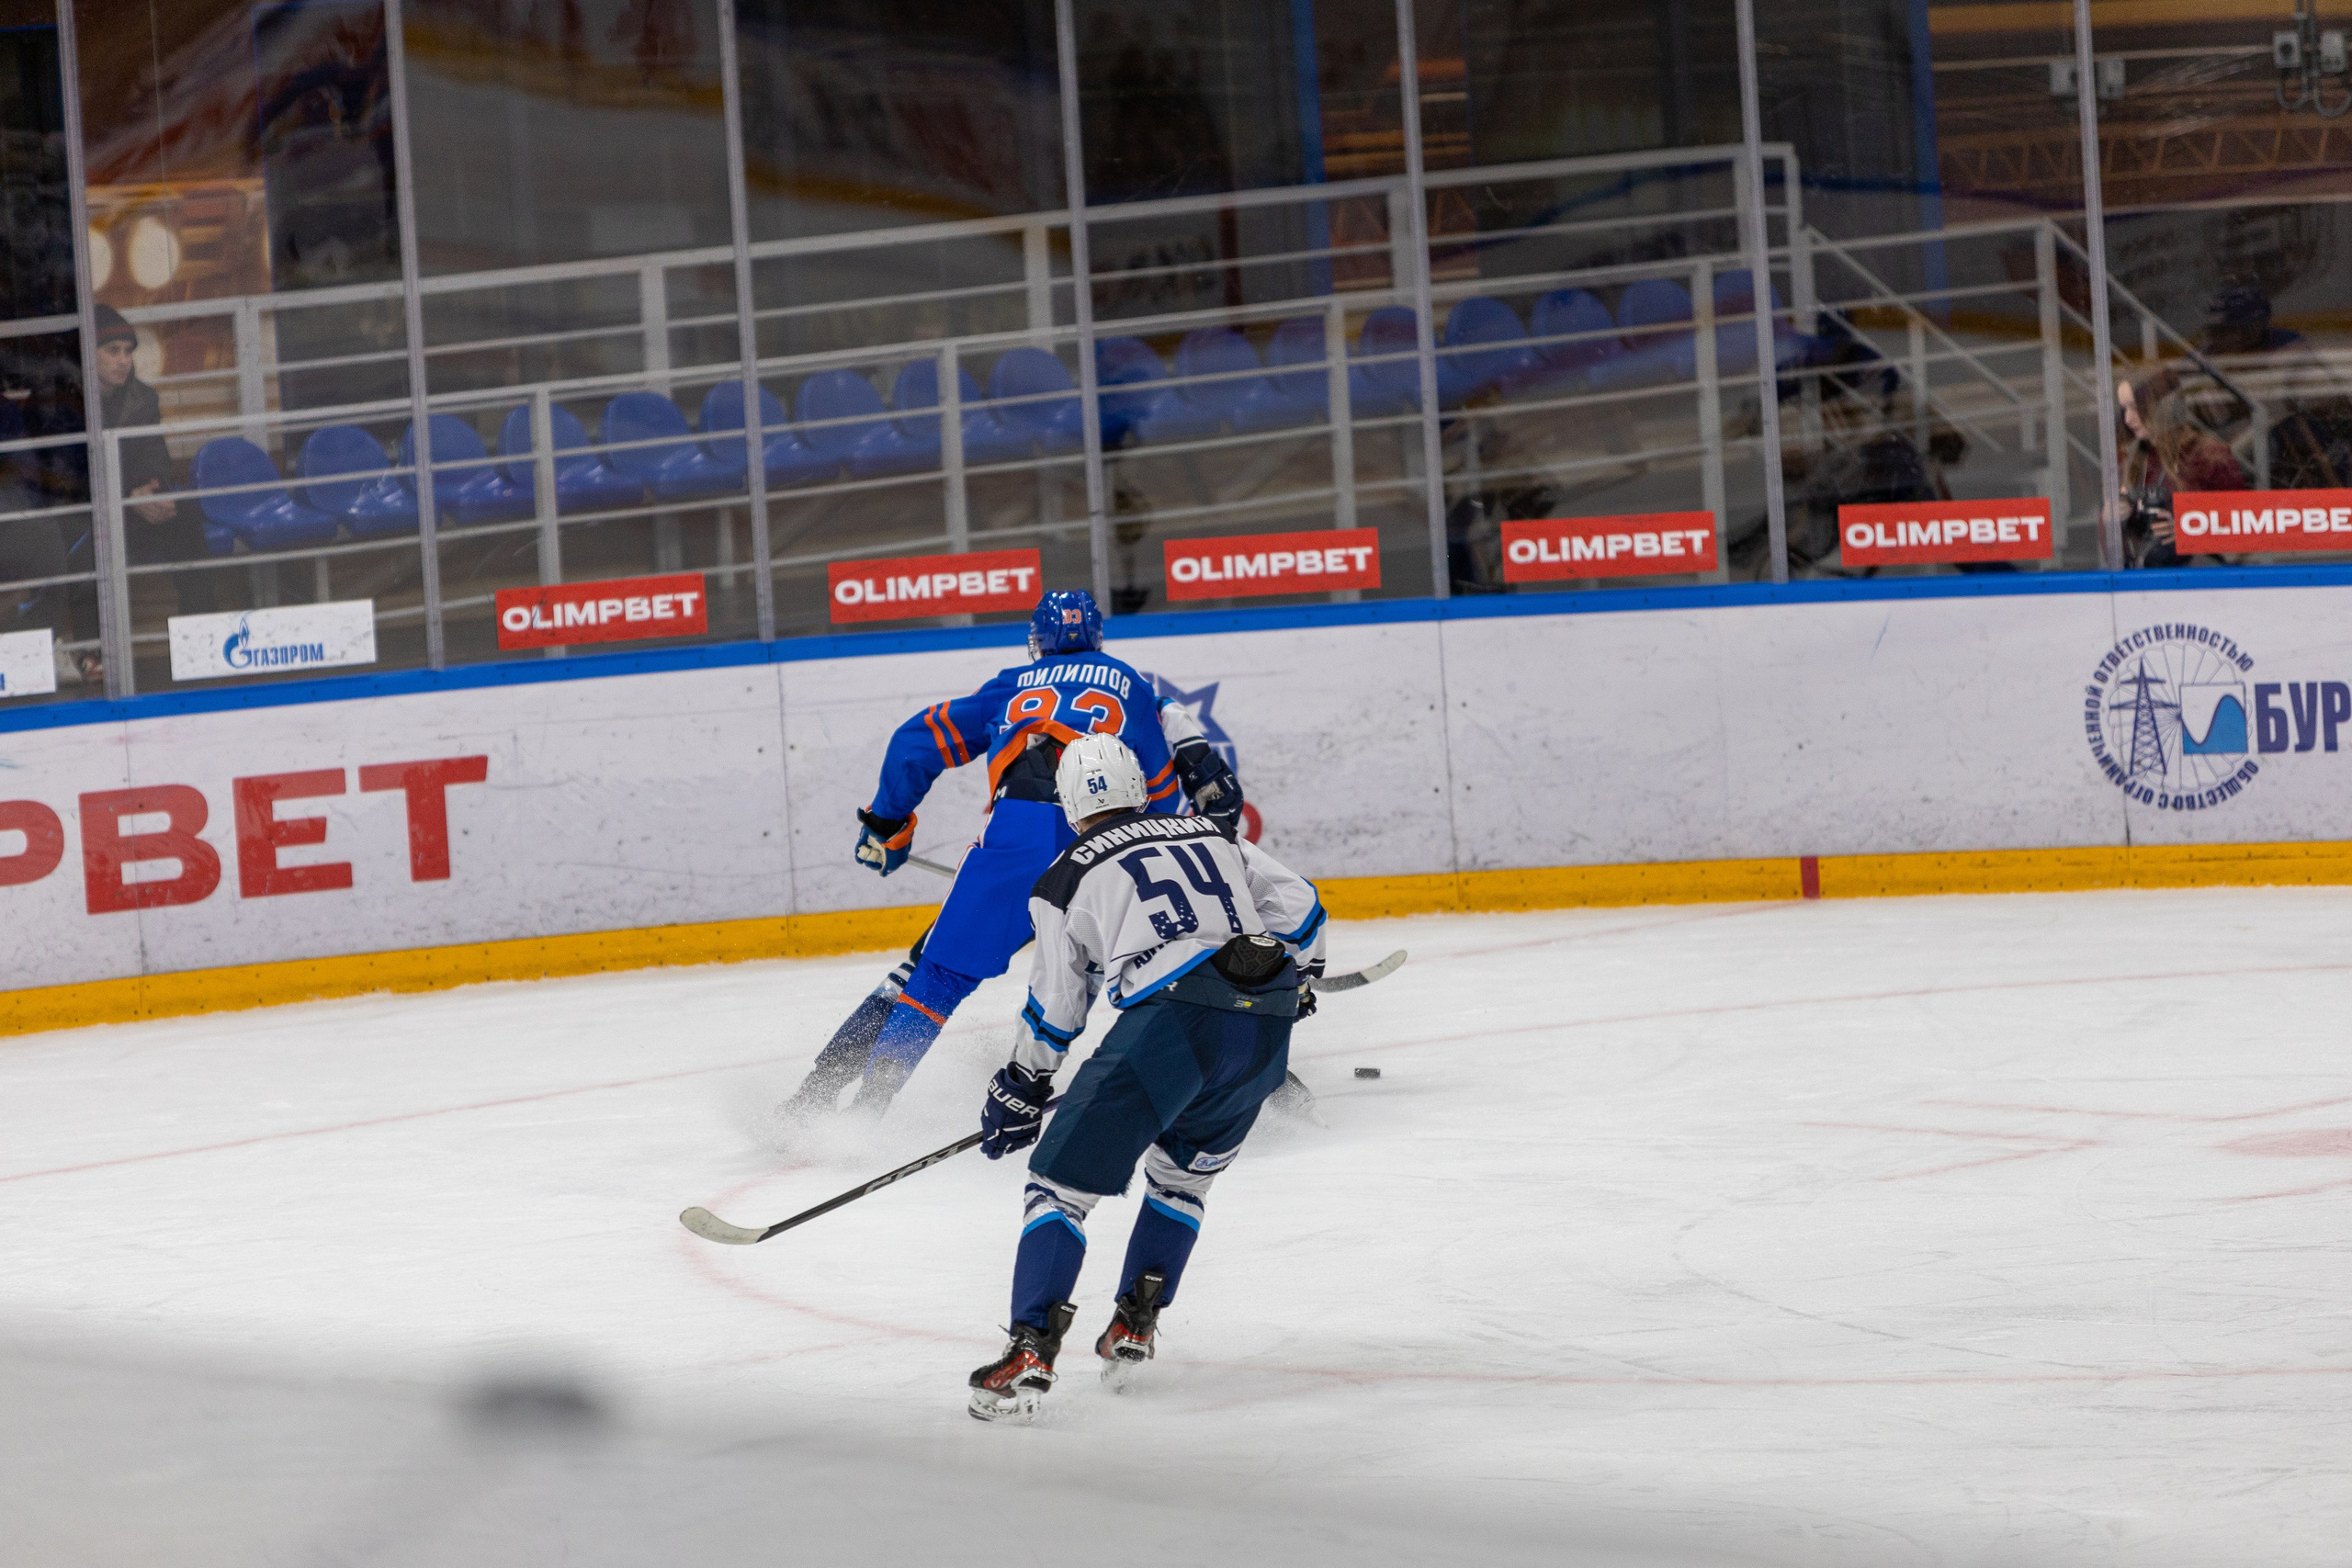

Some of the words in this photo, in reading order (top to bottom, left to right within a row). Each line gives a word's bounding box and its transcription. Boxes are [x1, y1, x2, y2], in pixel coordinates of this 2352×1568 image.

[1509, 529, 1710, 563] OLIMPBET
[1846, 516, 2045, 548] OLIMPBET
[1170, 547, 1373, 582] OLIMPBET
[834, 567, 1035, 604] OLIMPBET
[502, 592, 699, 631] OLIMPBET
[253, 642, 324, 668] ГАЗПРОМ
[2094, 623, 2255, 683] ОТВЕТСТВЕННОСТЬЮ
[1017, 664, 1132, 700] ФИЛИППОВ
[1000, 684, 1126, 736] 93
[2254, 681, 2352, 752] БУР
[2084, 684, 2154, 805] ОГРАНИЧЕННОЙ
[1086, 775, 1108, 795] 54
[2157, 793, 2169, 810] С
[2172, 759, 2259, 811] ОБЩЕСТВО
[1070, 816, 1222, 865] СИНИЦКИЙ
[1116, 841, 1244, 940] 54
